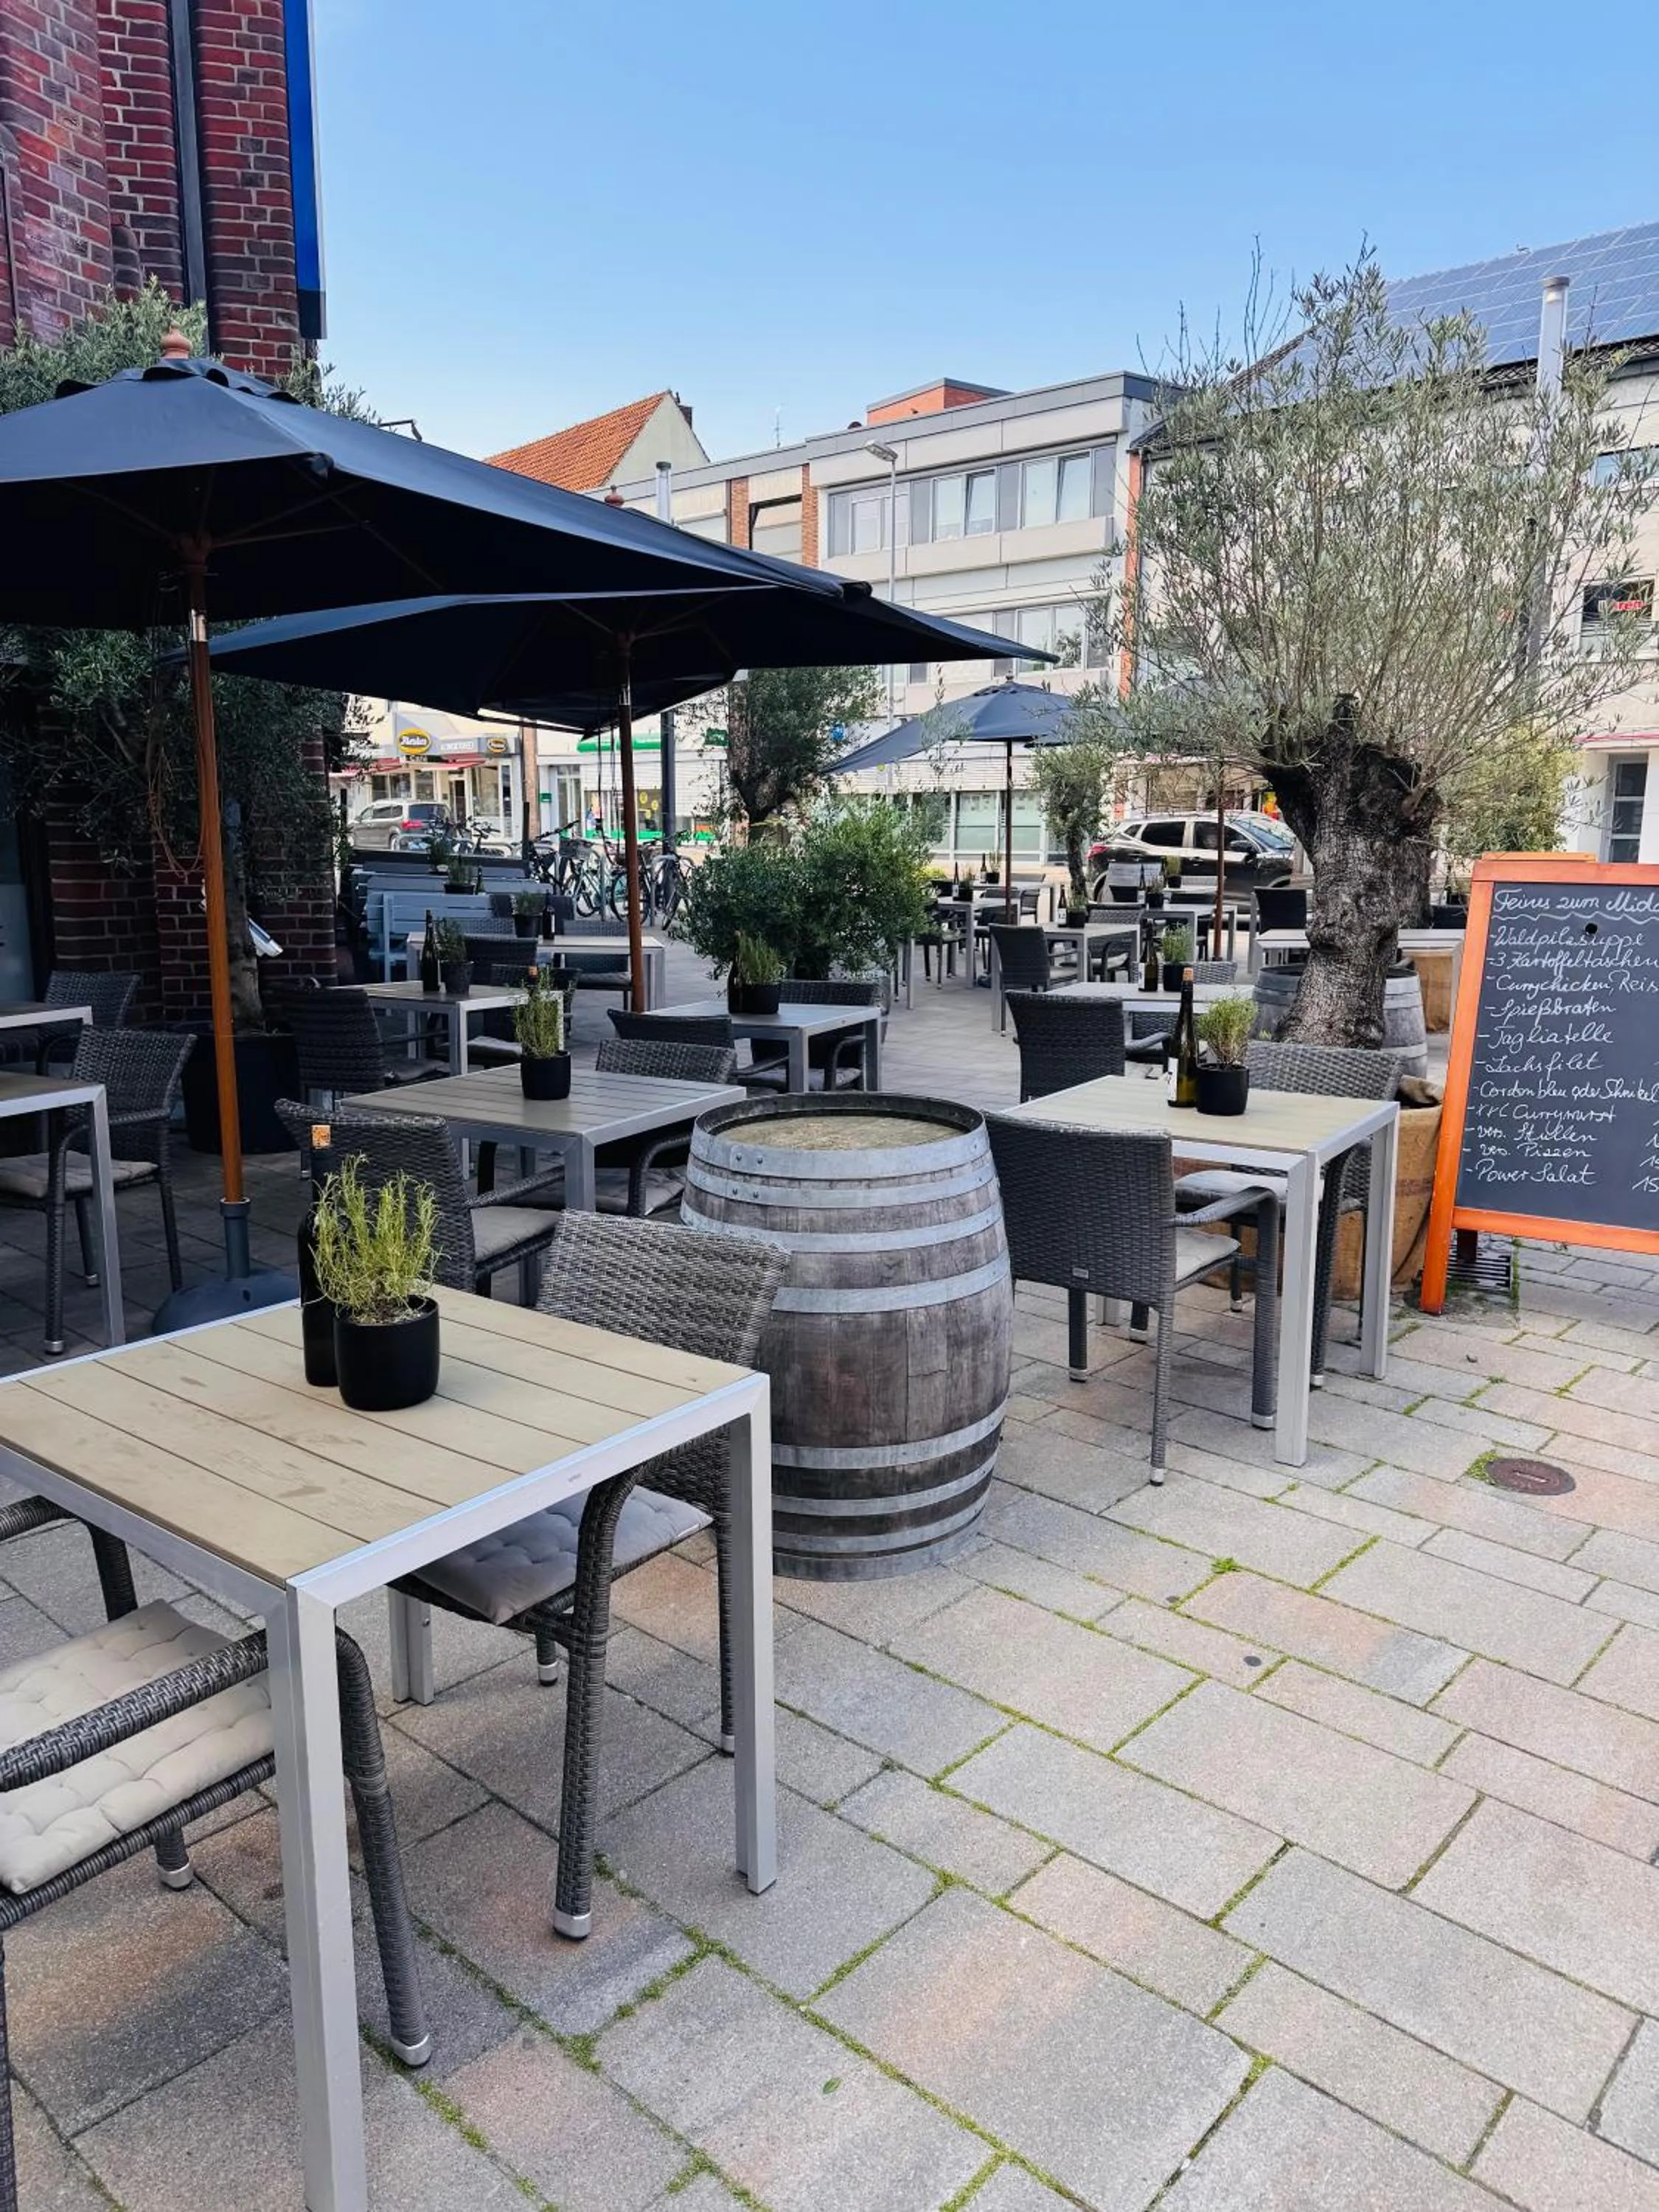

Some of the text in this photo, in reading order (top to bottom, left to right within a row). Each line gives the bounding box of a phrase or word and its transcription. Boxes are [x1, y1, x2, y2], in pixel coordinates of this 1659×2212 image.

[1556, 897, 1599, 909] zum
[1490, 995, 1617, 1028] Spießbraten
[1487, 1022, 1614, 1054] Tagliatelle
[1486, 1051, 1605, 1082] Lachsfilet
[1517, 1142, 1593, 1158] Pizzen
[1475, 1158, 1529, 1182] Power
[1530, 1163, 1596, 1185] Salat
